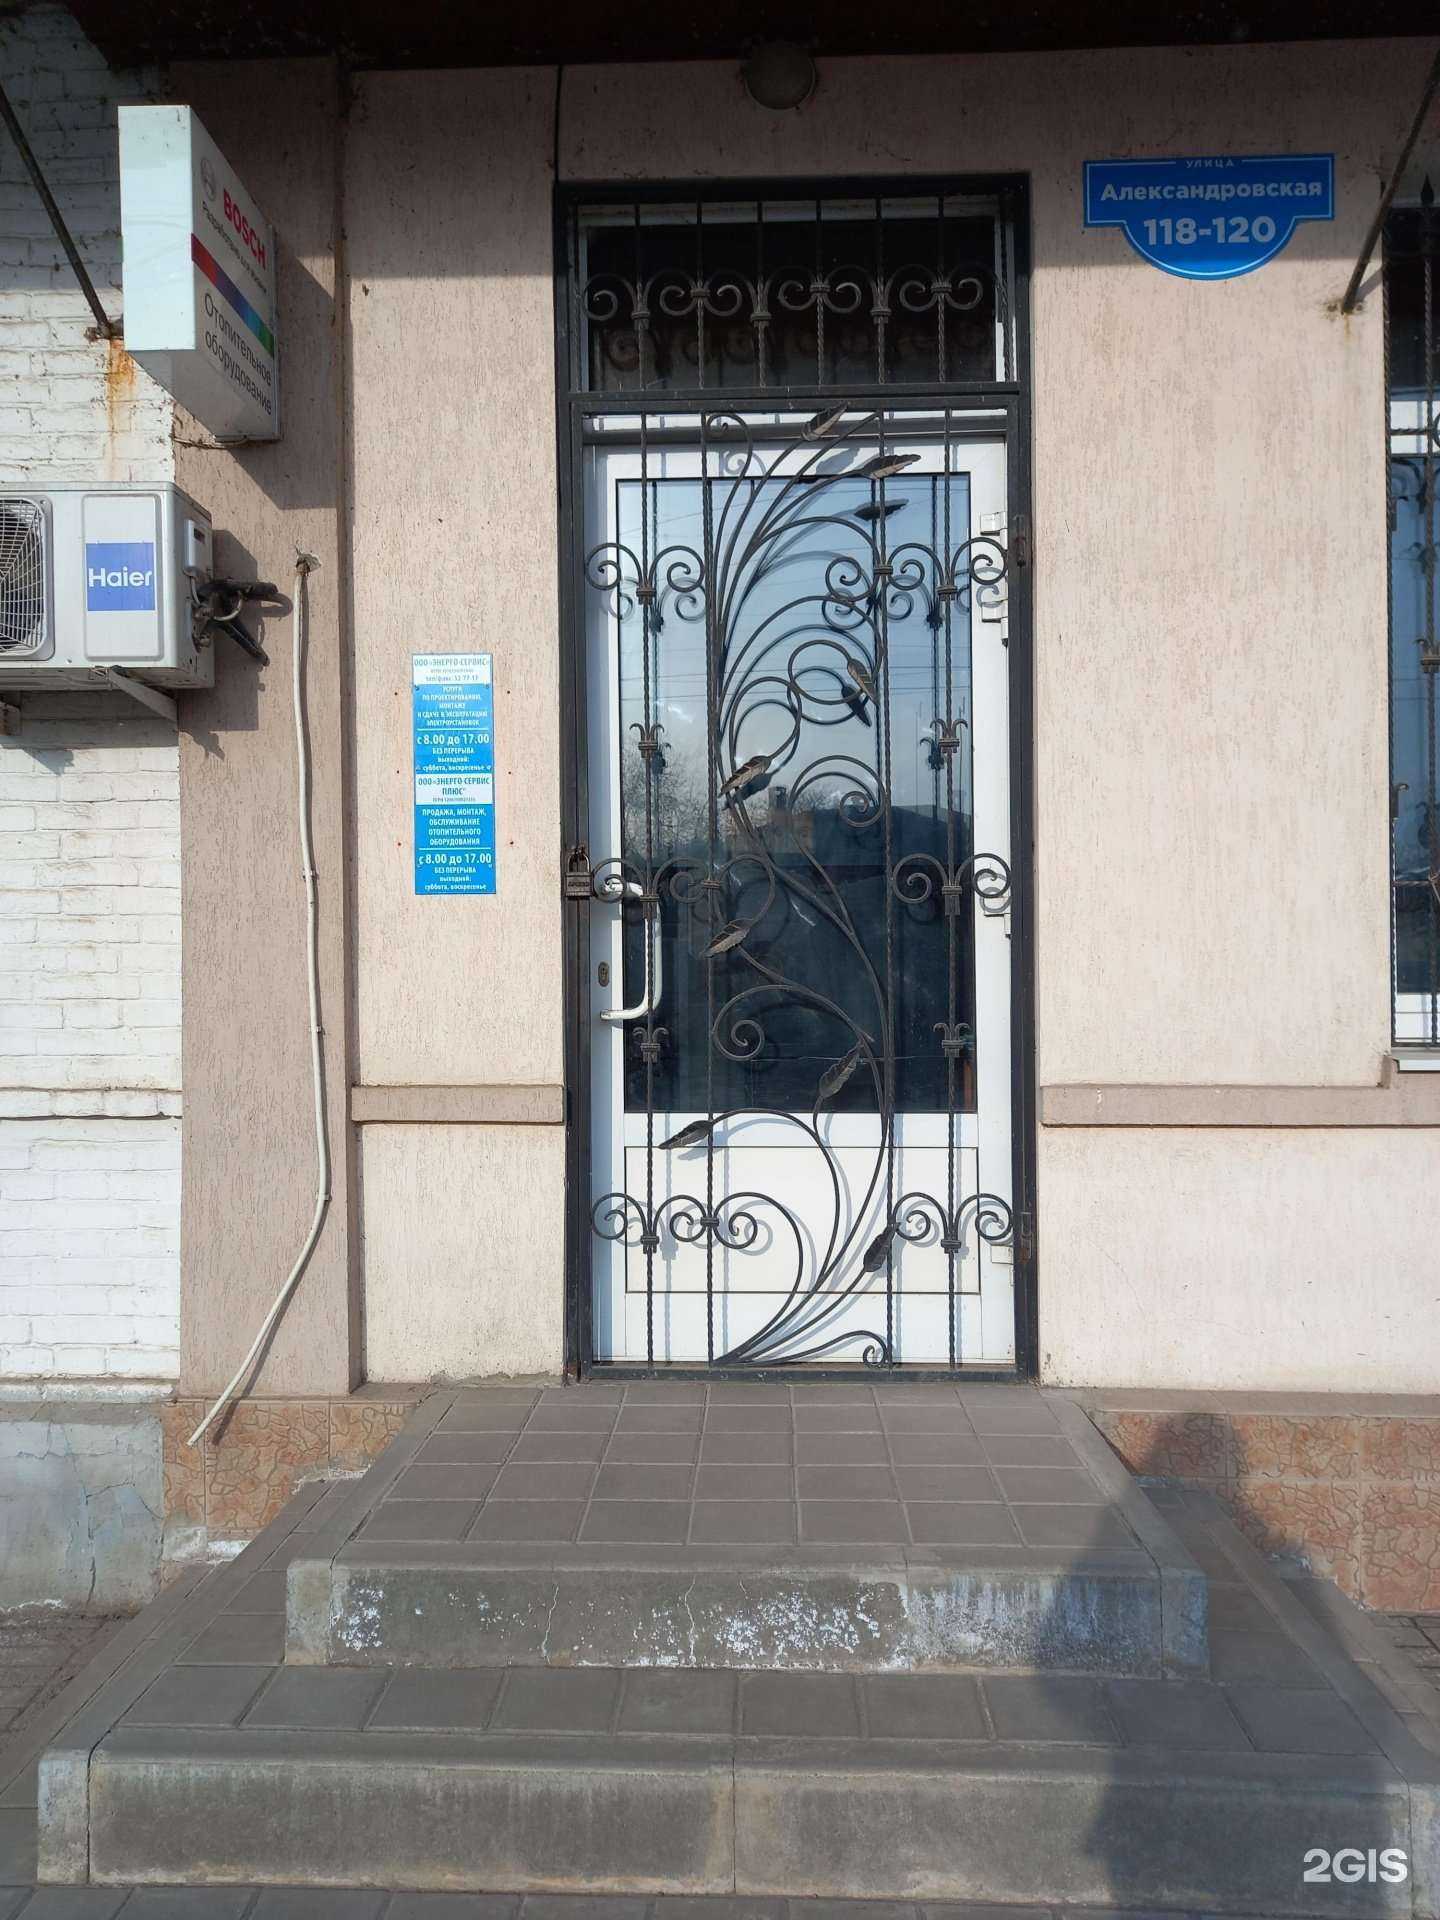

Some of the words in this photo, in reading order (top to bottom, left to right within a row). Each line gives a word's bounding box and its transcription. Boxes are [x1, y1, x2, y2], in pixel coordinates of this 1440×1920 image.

[1186, 159, 1235, 168] УЛИЦА
[1100, 181, 1323, 202] Александровская
[223, 187, 266, 271] BOSCH
[1143, 215, 1276, 246] 118-120
[204, 292, 272, 387] Отопительное
[204, 331, 272, 416] оборудование
[88, 566, 153, 588] Haier
[423, 734, 445, 745] 8.00
[447, 736, 460, 746] до
[462, 733, 490, 745] 17.00
[432, 747, 443, 755] БЕЗ
[443, 747, 474, 755] ПЕРЕРЫВА
[418, 777, 432, 786] ООО
[422, 808, 456, 816] ПРОДАЖА,
[456, 808, 487, 816] МОНТАЖ,
[429, 818, 481, 826] ОБСЛУЖИВАНИЕ
[428, 828, 481, 836] ОТОПИТЕЛЬНОГО
[429, 838, 480, 846] ОБОРУДОВАНИЯ
[425, 854, 447, 864] 8.00
[449, 855, 462, 866] до
[464, 853, 492, 864] 17.00
[434, 866, 445, 874] БЕЗ
[446, 866, 477, 874] ПЕРЕРЫВА
